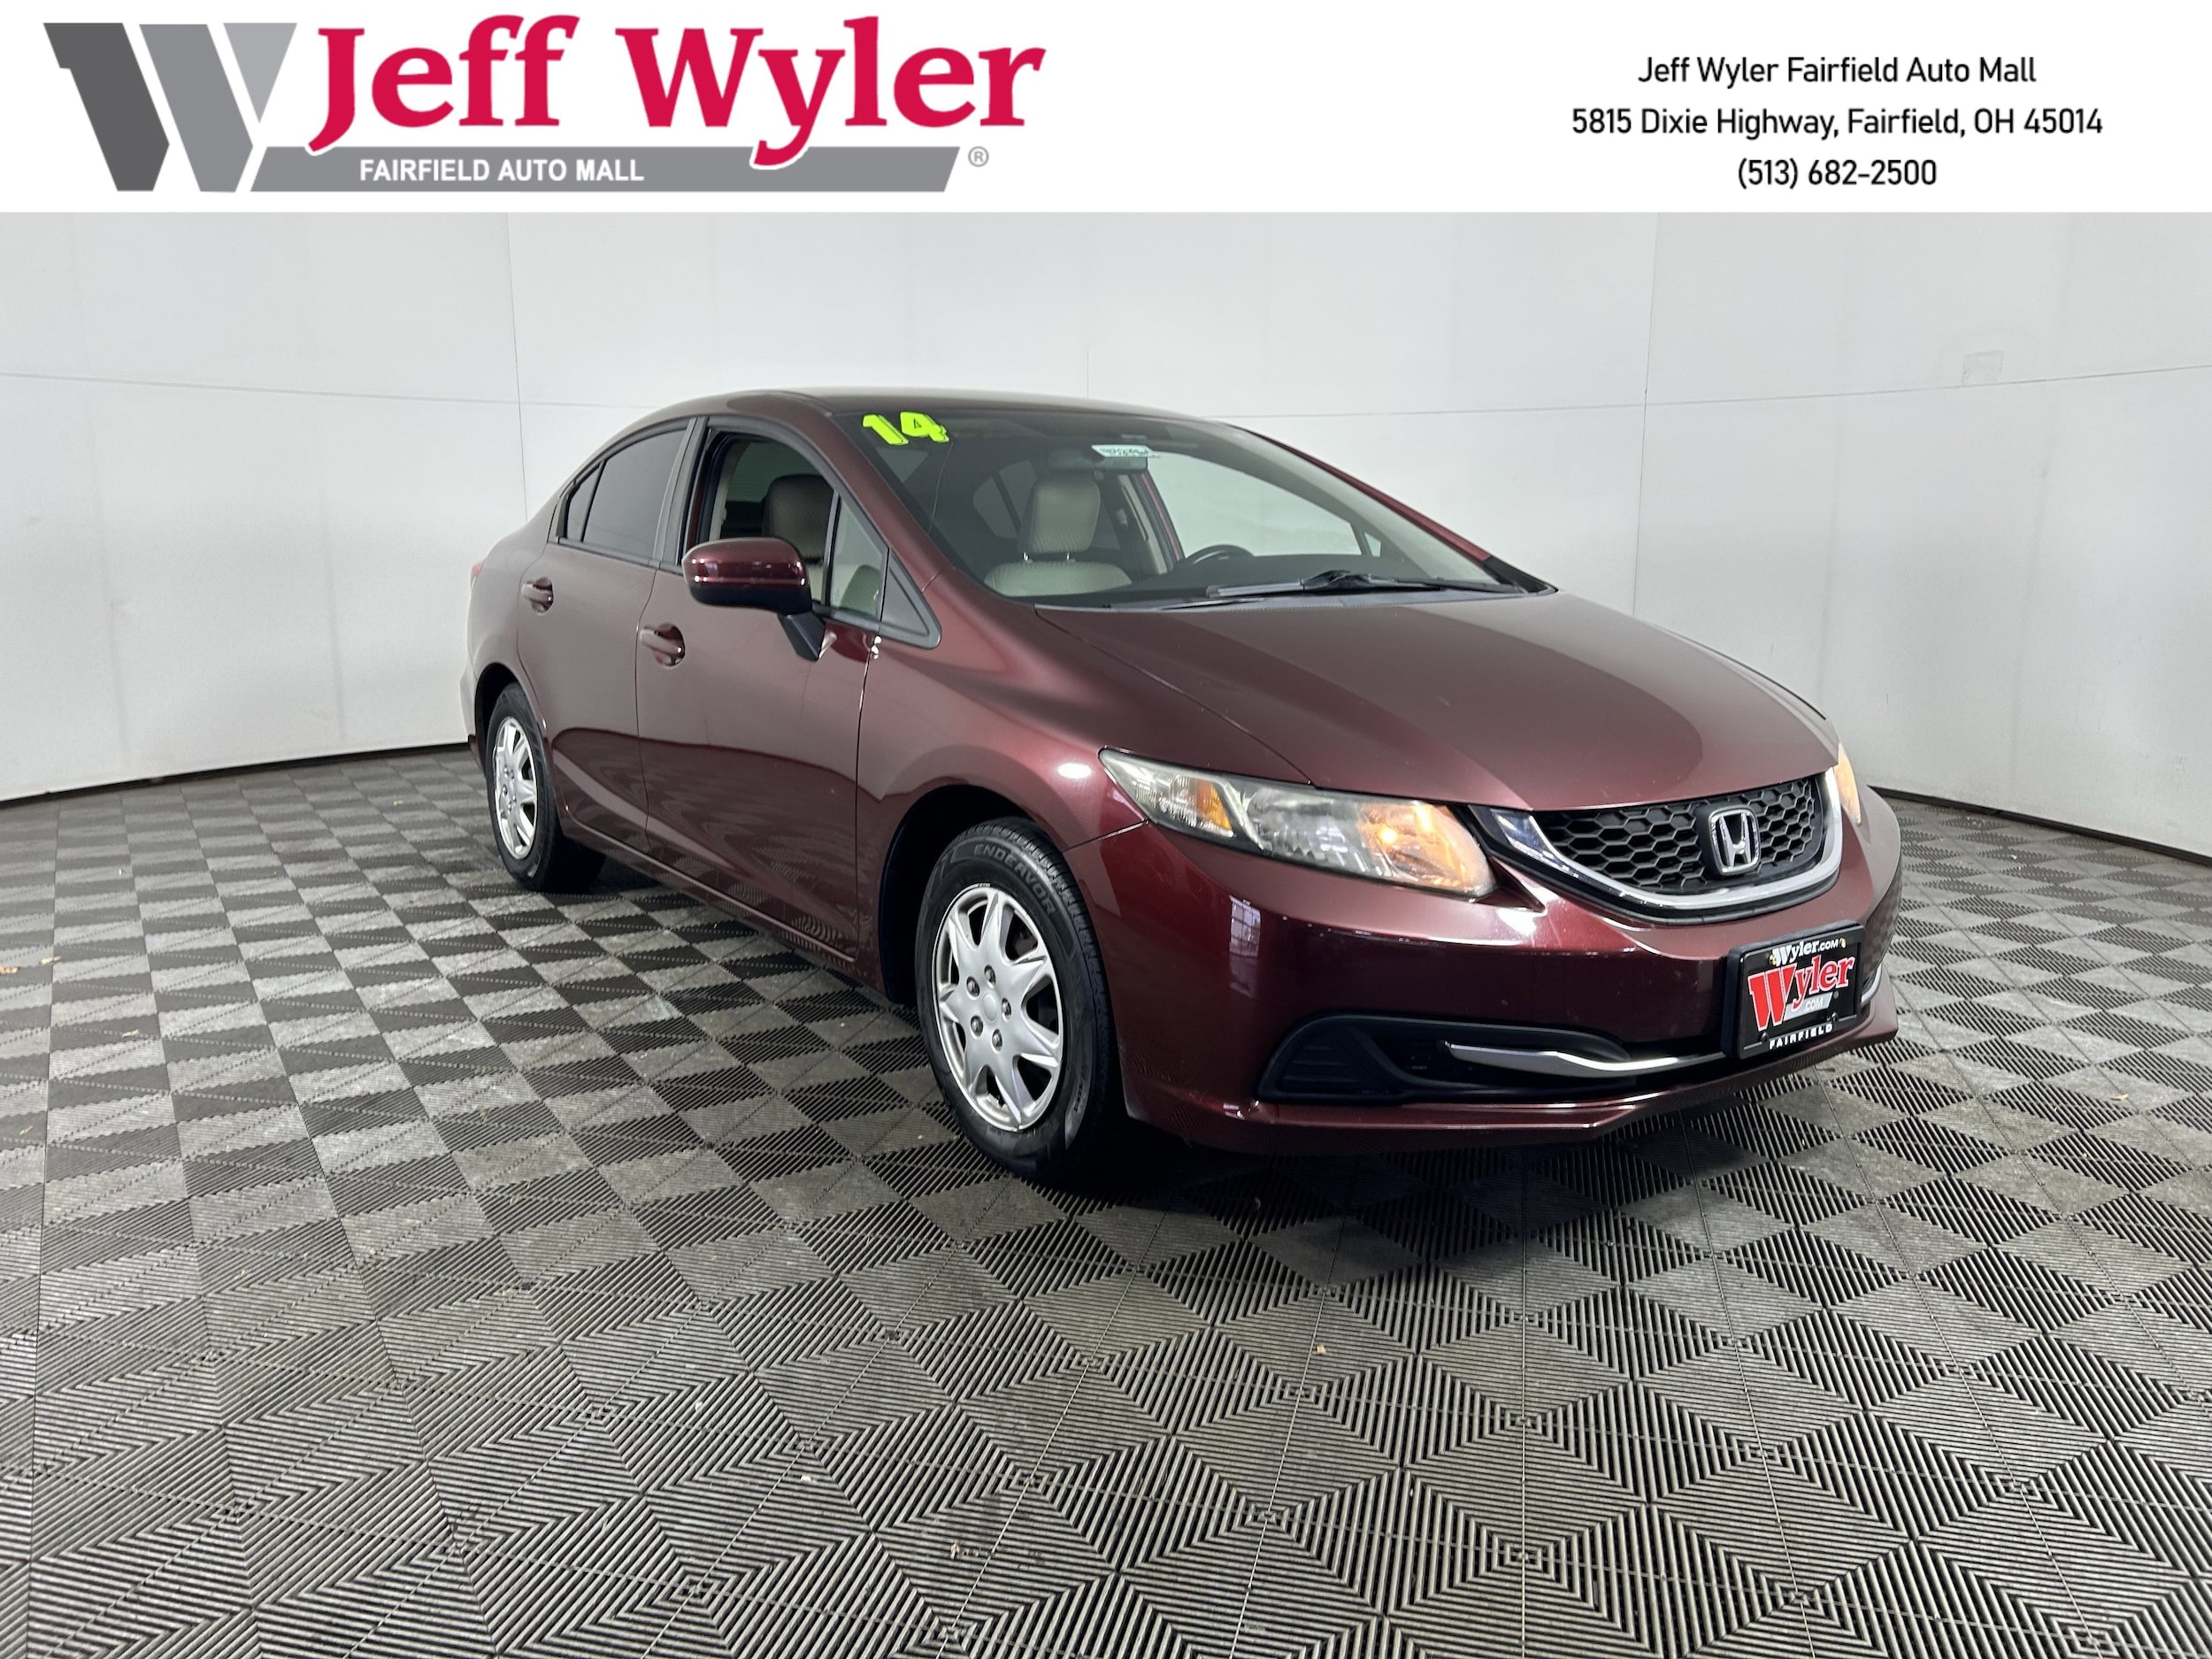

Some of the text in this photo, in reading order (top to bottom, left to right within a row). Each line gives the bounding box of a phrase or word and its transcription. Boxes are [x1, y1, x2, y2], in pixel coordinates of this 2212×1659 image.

[863, 411, 950, 445] 14
[973, 843, 1056, 915] ENDEAVOR
[1747, 955, 1855, 1032] Wyler
[1770, 1023, 1833, 1050] FAIRFIELD
